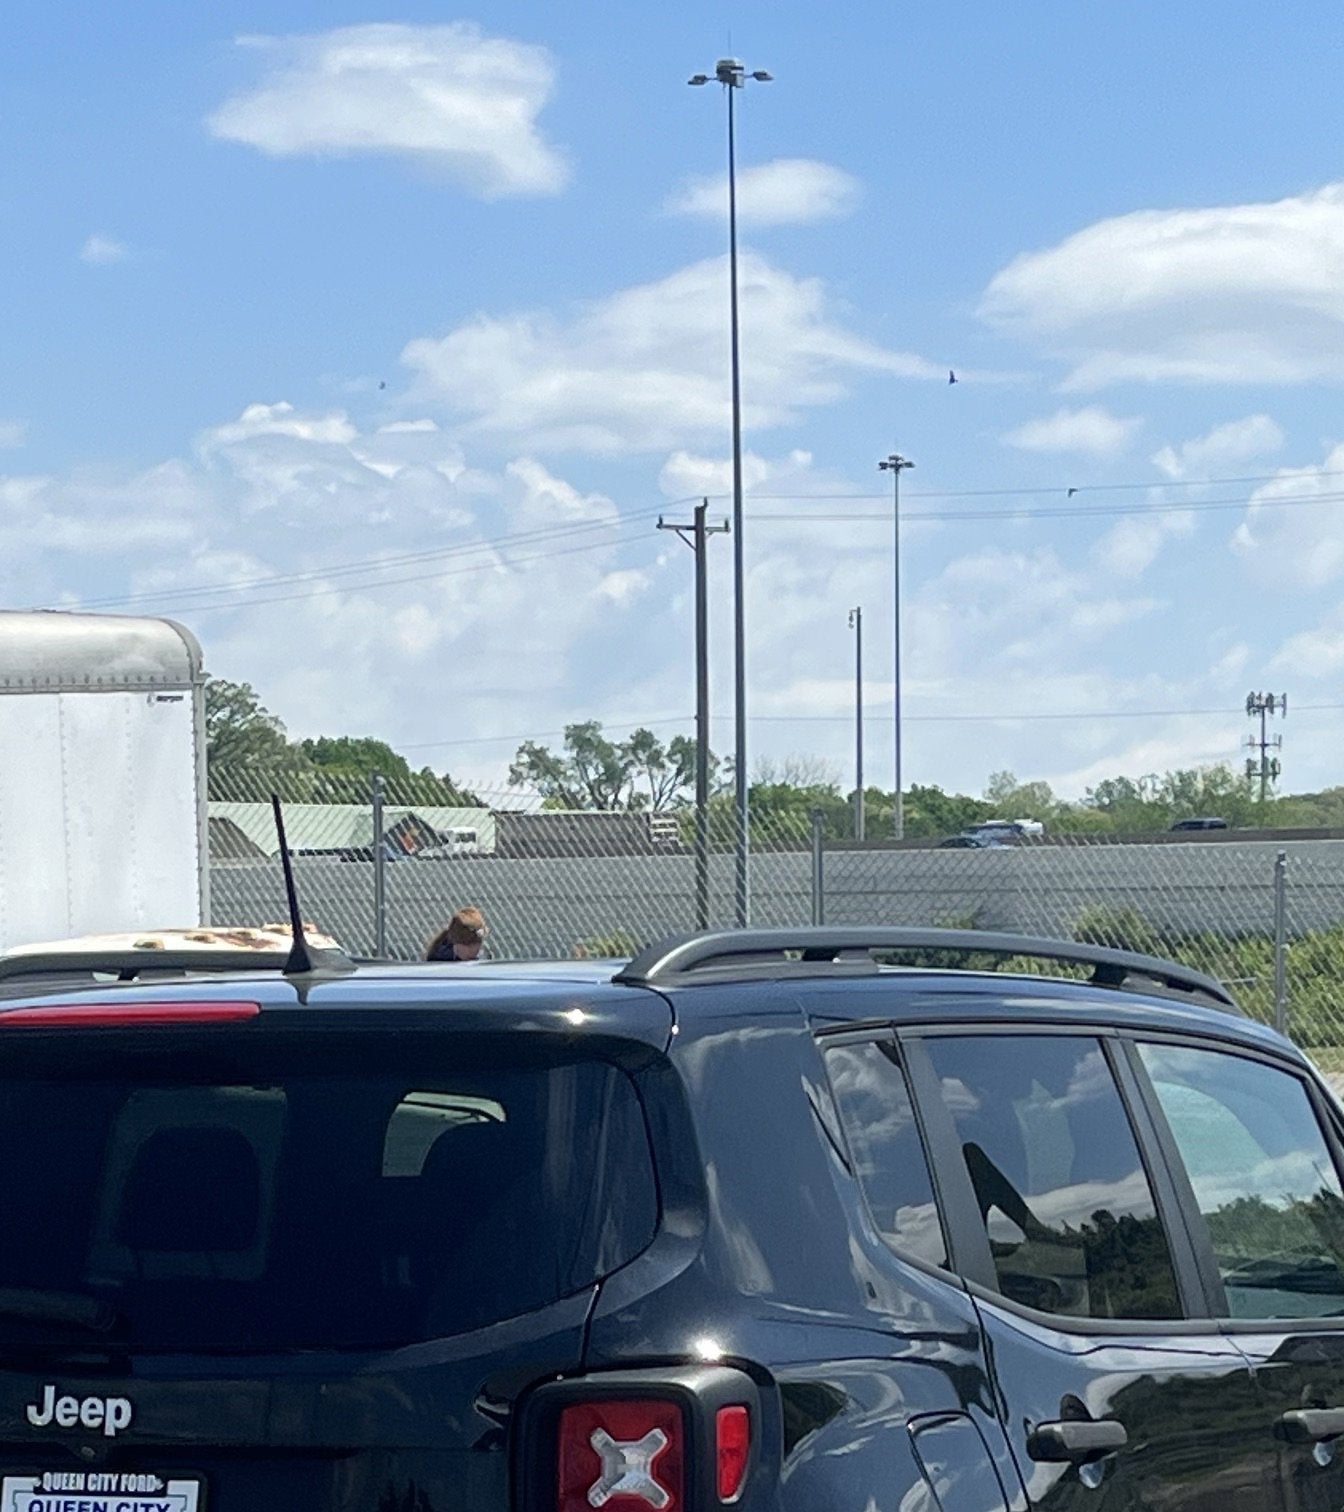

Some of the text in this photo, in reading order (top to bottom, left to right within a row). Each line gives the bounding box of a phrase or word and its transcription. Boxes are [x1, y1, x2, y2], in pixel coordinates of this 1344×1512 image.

[26, 1384, 132, 1436] Jeep
[42, 1471, 156, 1492] QUEEN CITY FORD
